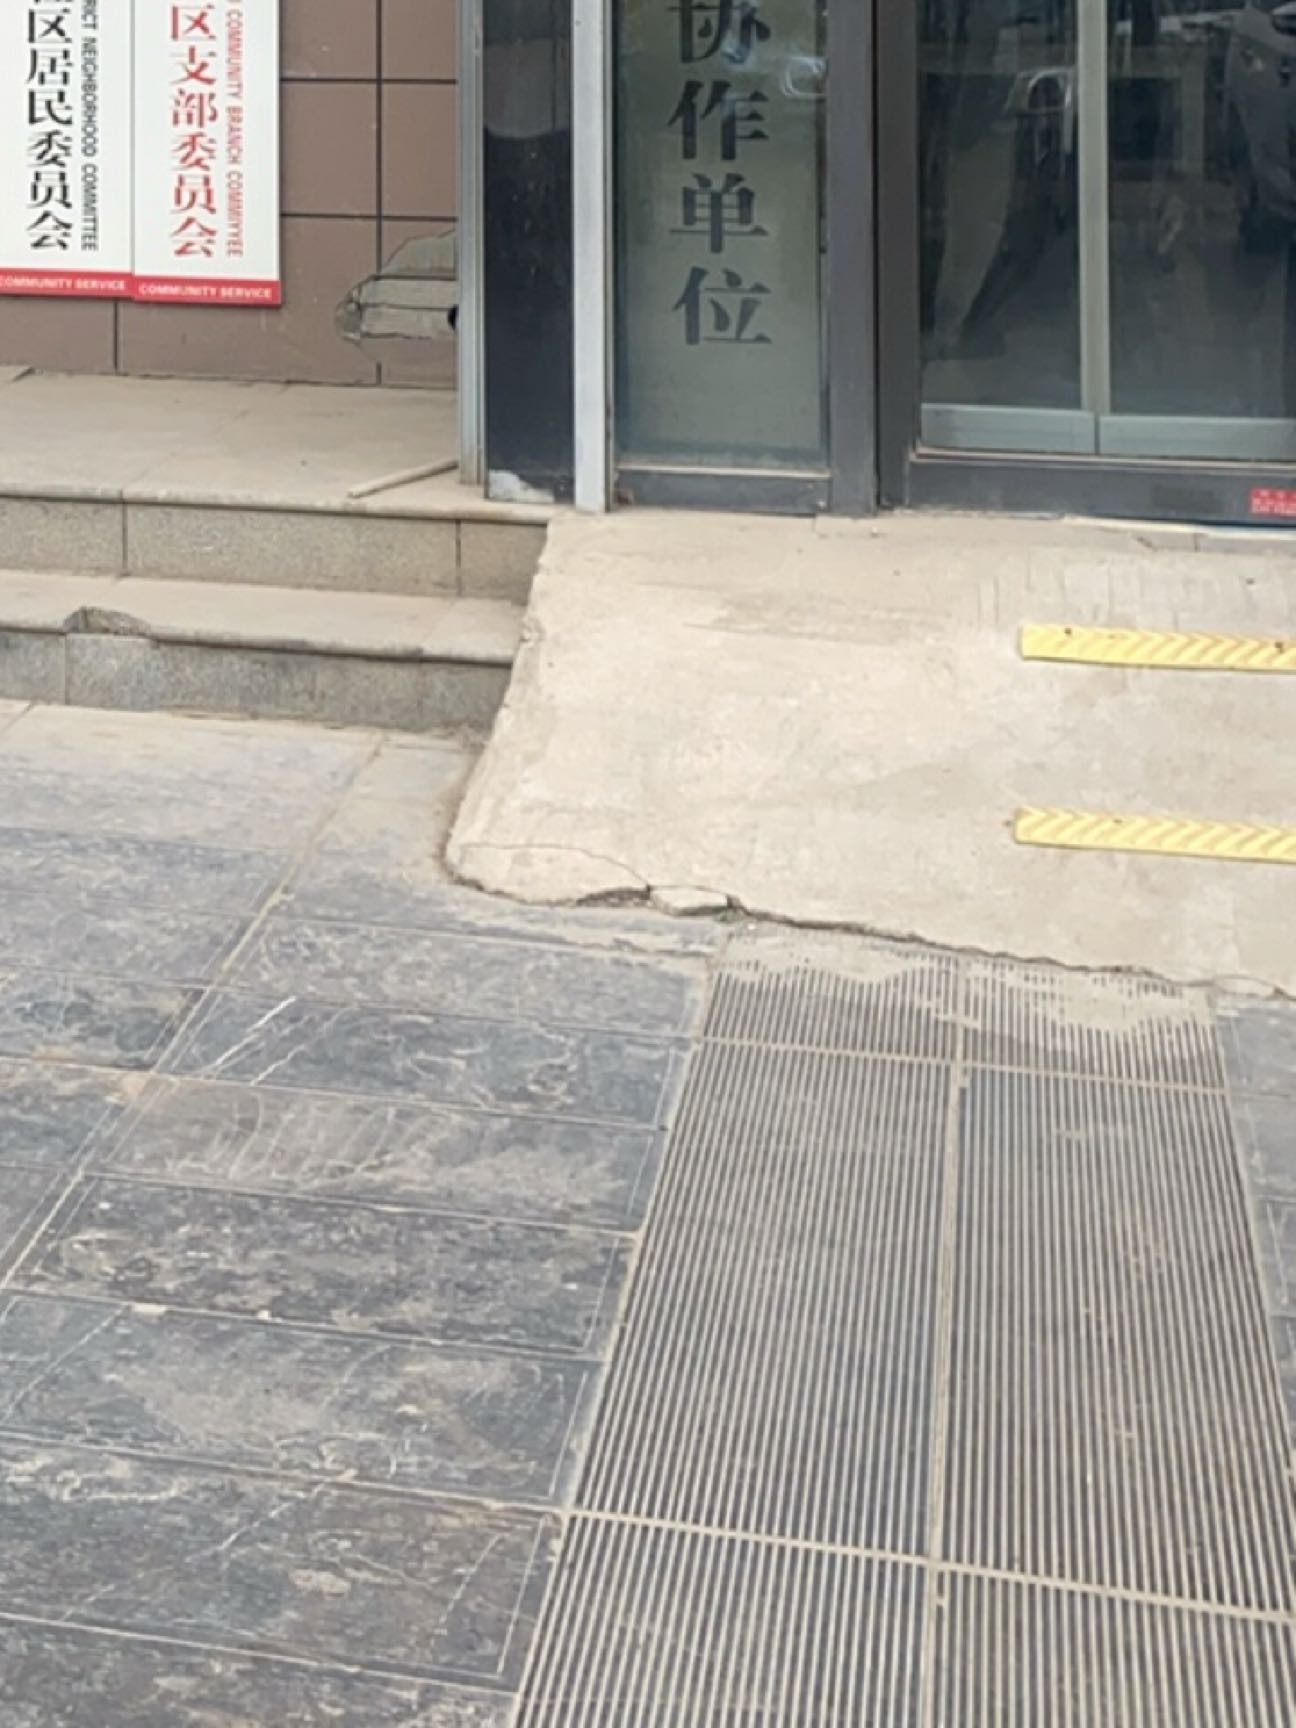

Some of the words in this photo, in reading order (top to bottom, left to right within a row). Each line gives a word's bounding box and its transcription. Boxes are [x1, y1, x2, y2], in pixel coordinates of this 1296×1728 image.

[226, 9, 244, 99] COMMUNITY
[81, 36, 99, 157] NEIGHBORHOOD
[226, 105, 244, 165] BRANCH
[81, 162, 99, 251] COMMITTEE
[75, 277, 126, 291] SERVICE
[139, 283, 217, 298] COMMUNITY
[220, 286, 273, 299] SERVICE
